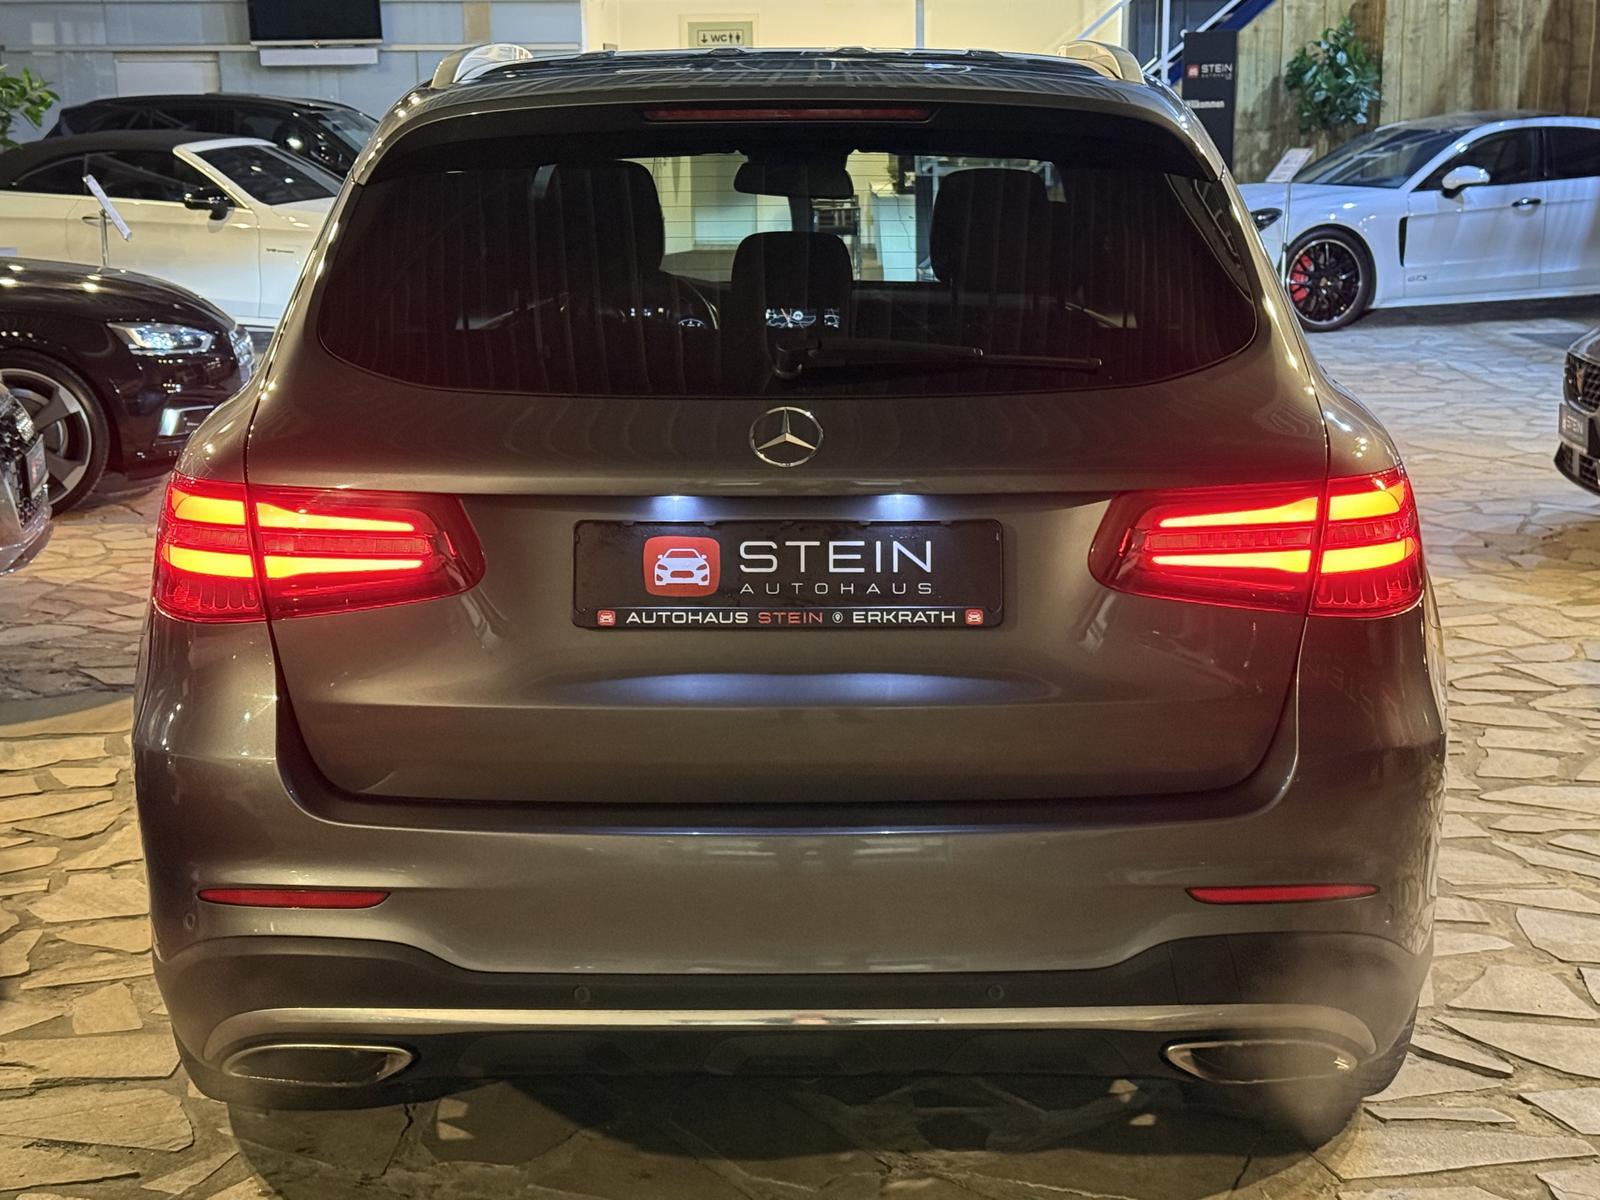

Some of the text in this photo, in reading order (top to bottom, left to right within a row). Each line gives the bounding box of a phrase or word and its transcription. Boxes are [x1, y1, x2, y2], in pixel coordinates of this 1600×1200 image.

[710, 34, 728, 42] WC
[1201, 63, 1232, 73] STEIN
[739, 541, 932, 573] STEIN
[739, 583, 932, 595] AUTOHAUS
[626, 610, 957, 624] AUTOHAUS STEIN ERKRATH
